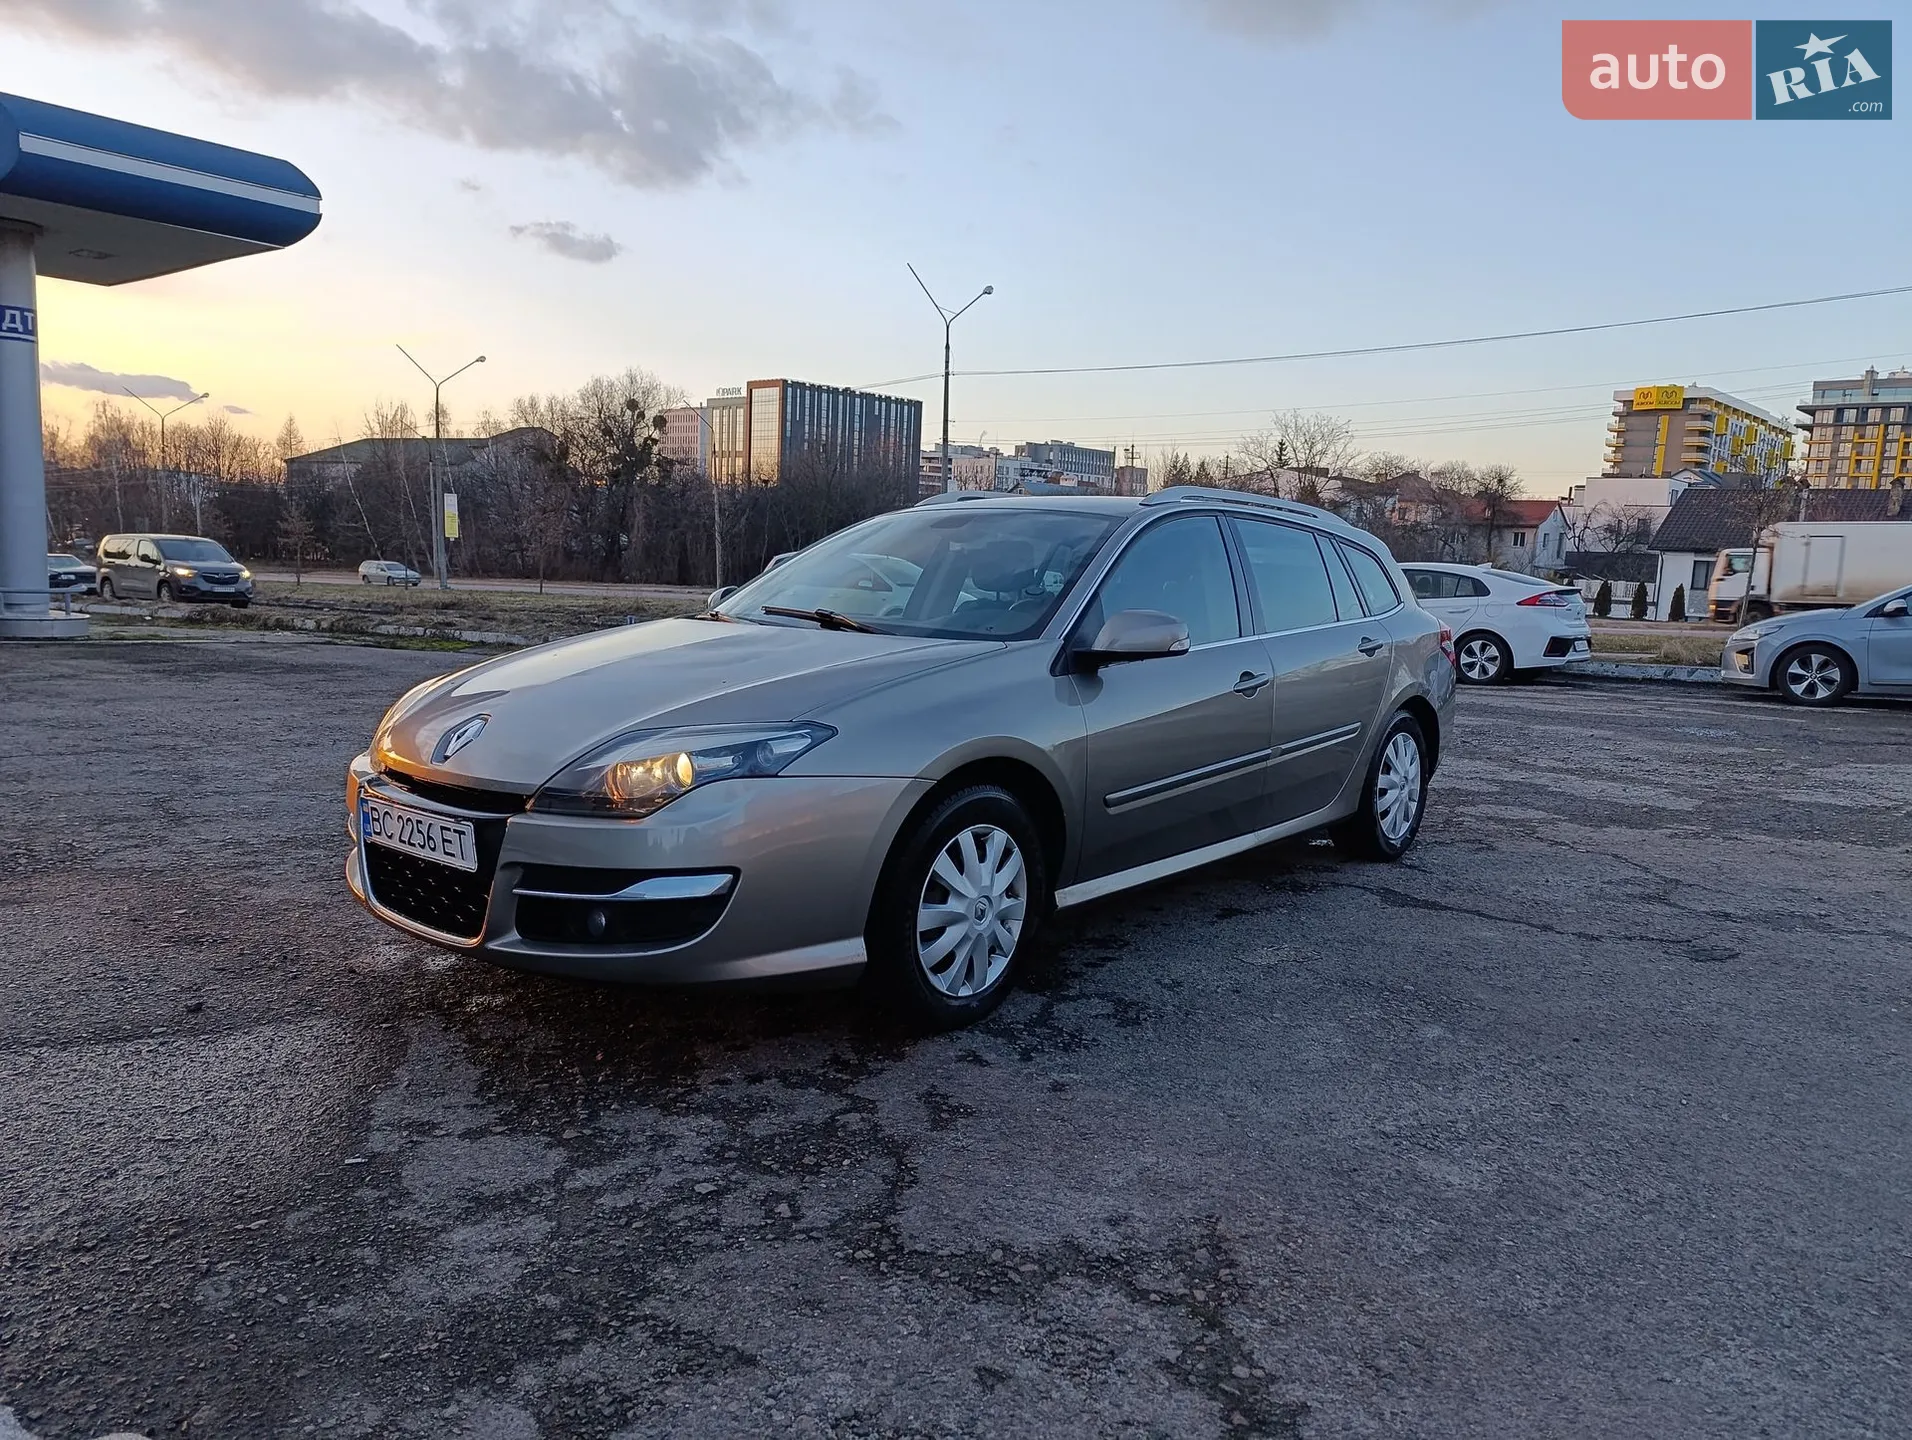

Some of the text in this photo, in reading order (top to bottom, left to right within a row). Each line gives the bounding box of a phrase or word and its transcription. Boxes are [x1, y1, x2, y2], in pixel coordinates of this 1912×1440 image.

[2, 309, 35, 332] ДТ
[370, 806, 467, 861] BC 2256 ET
